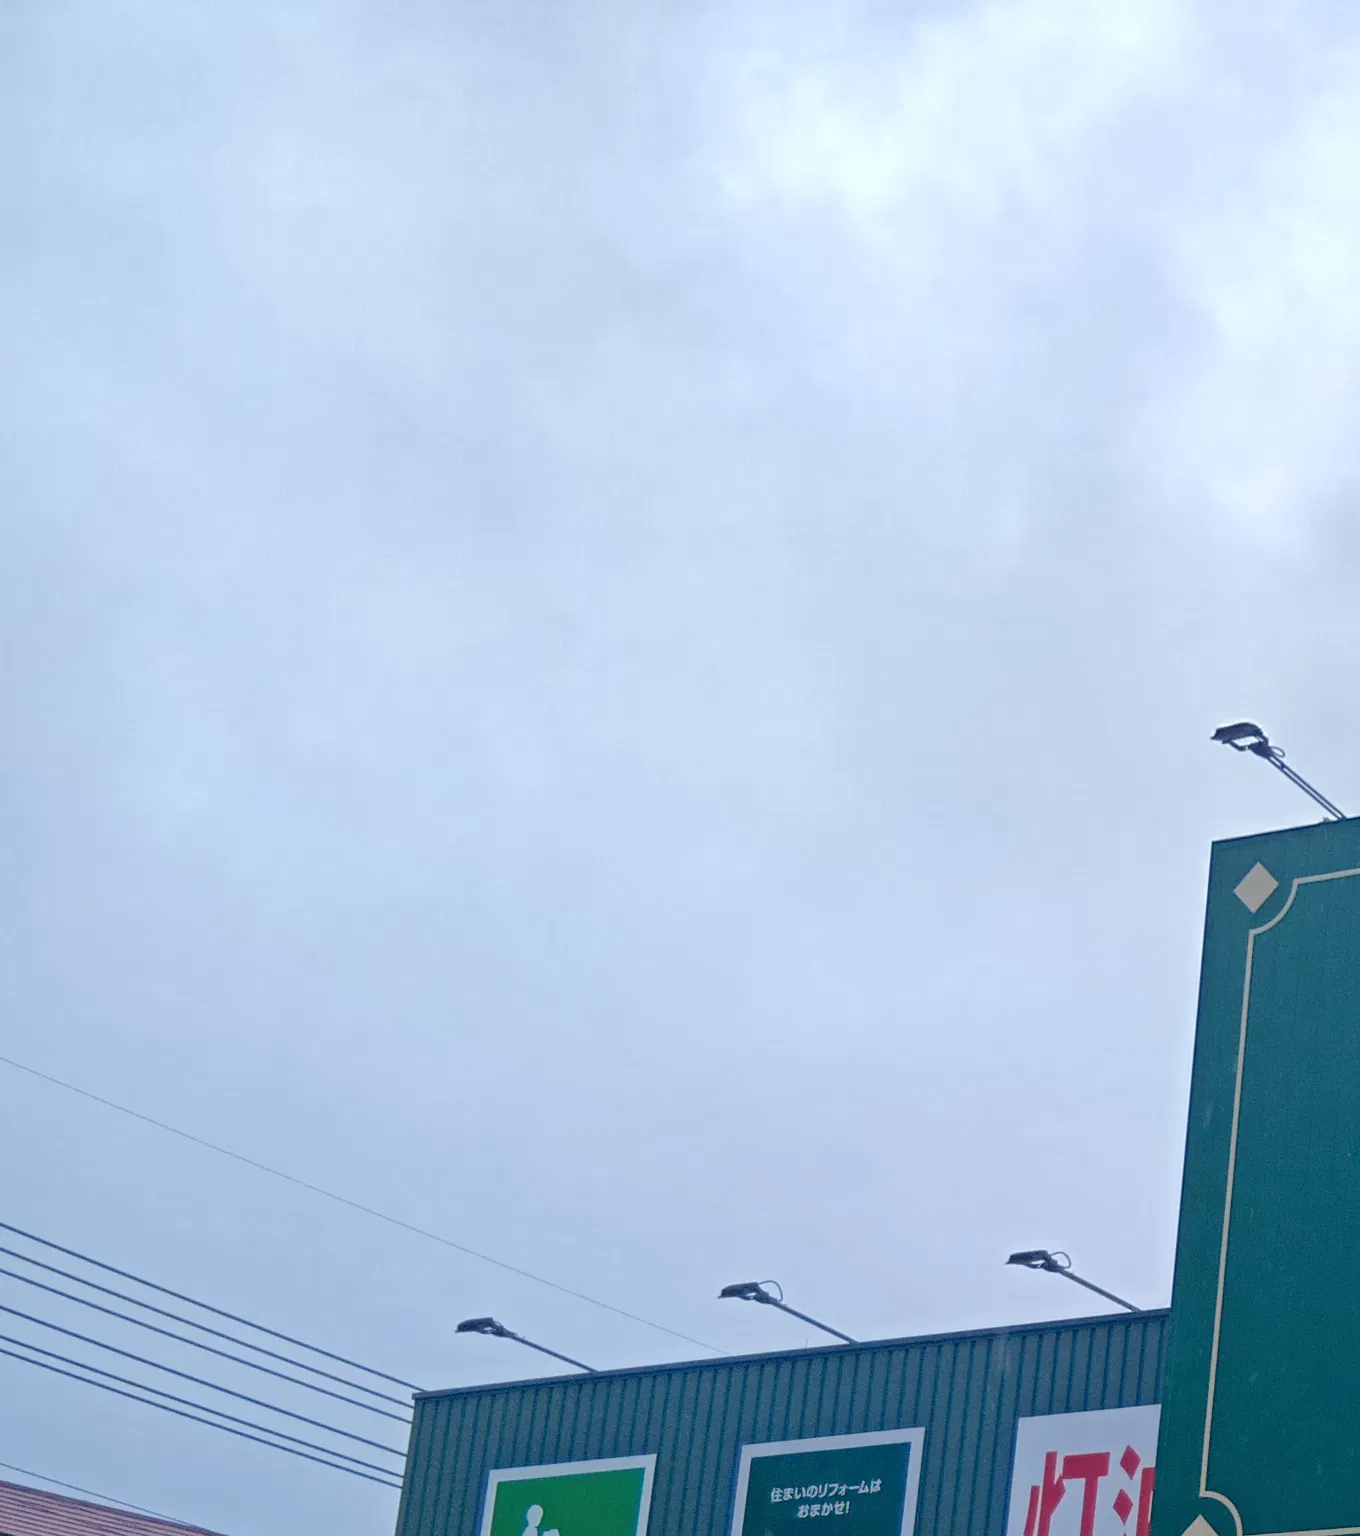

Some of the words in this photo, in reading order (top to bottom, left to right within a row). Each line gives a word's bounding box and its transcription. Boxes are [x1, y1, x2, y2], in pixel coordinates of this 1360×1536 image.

[770, 1479, 883, 1503] 住まいのリフォームは
